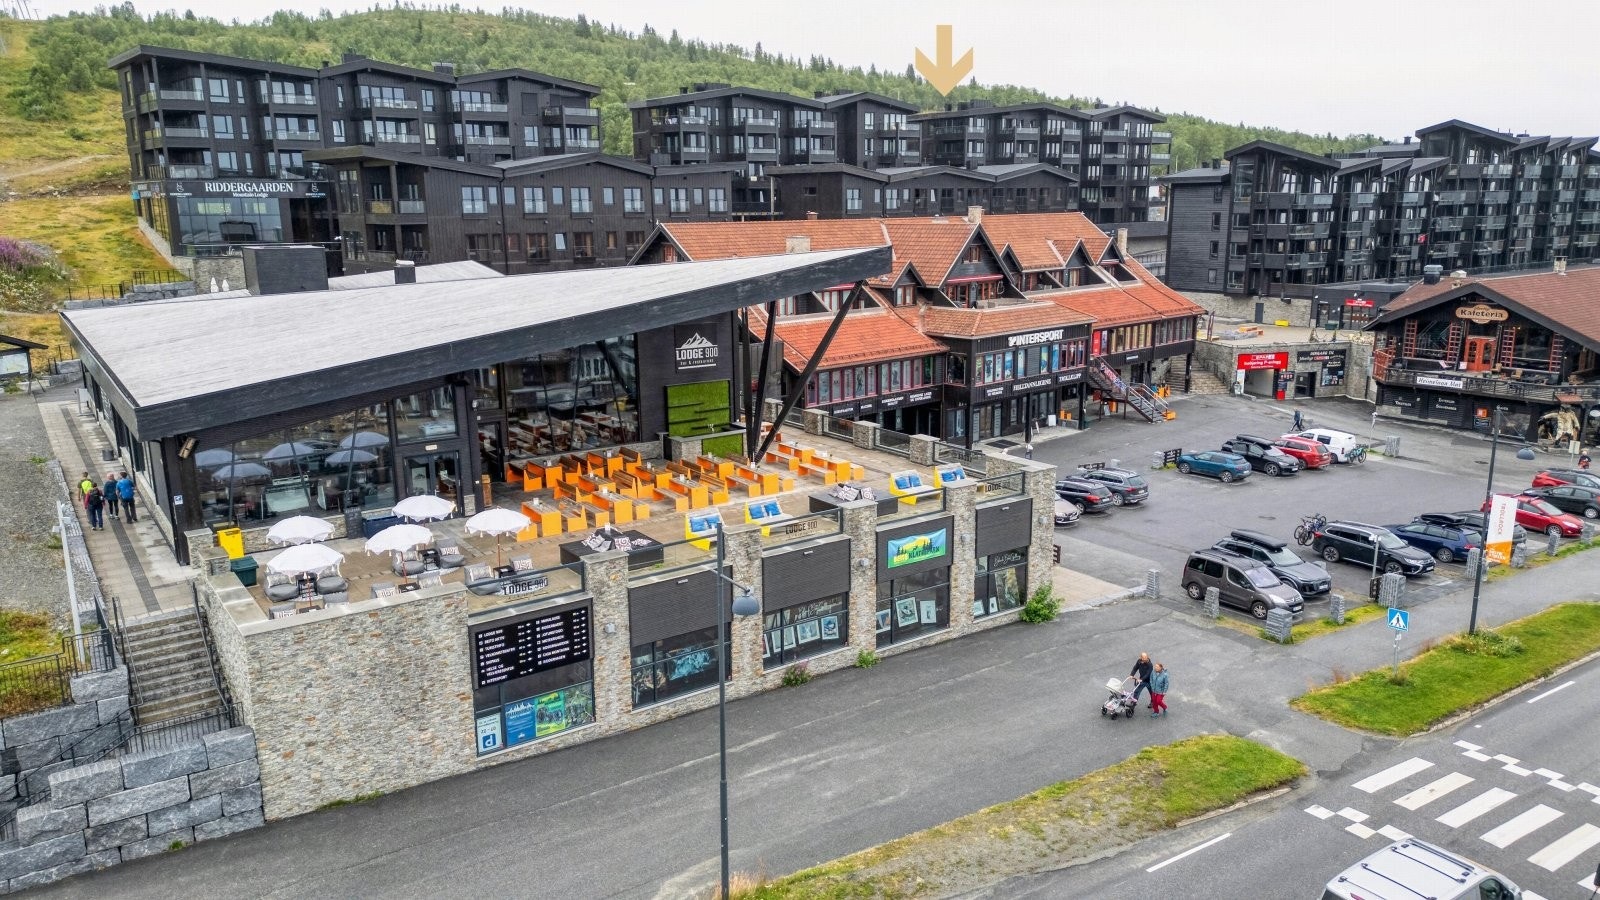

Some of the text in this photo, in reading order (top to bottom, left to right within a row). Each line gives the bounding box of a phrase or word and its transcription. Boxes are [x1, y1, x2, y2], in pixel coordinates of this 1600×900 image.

[205, 182, 294, 192] RIDDERGAARDEN
[1460, 309, 1503, 318] Kafeteria
[1015, 329, 1064, 346] INTERSPORT
[676, 347, 719, 360] LODGE 900
[785, 523, 806, 534] LODGE
[503, 581, 532, 596] LODGE
